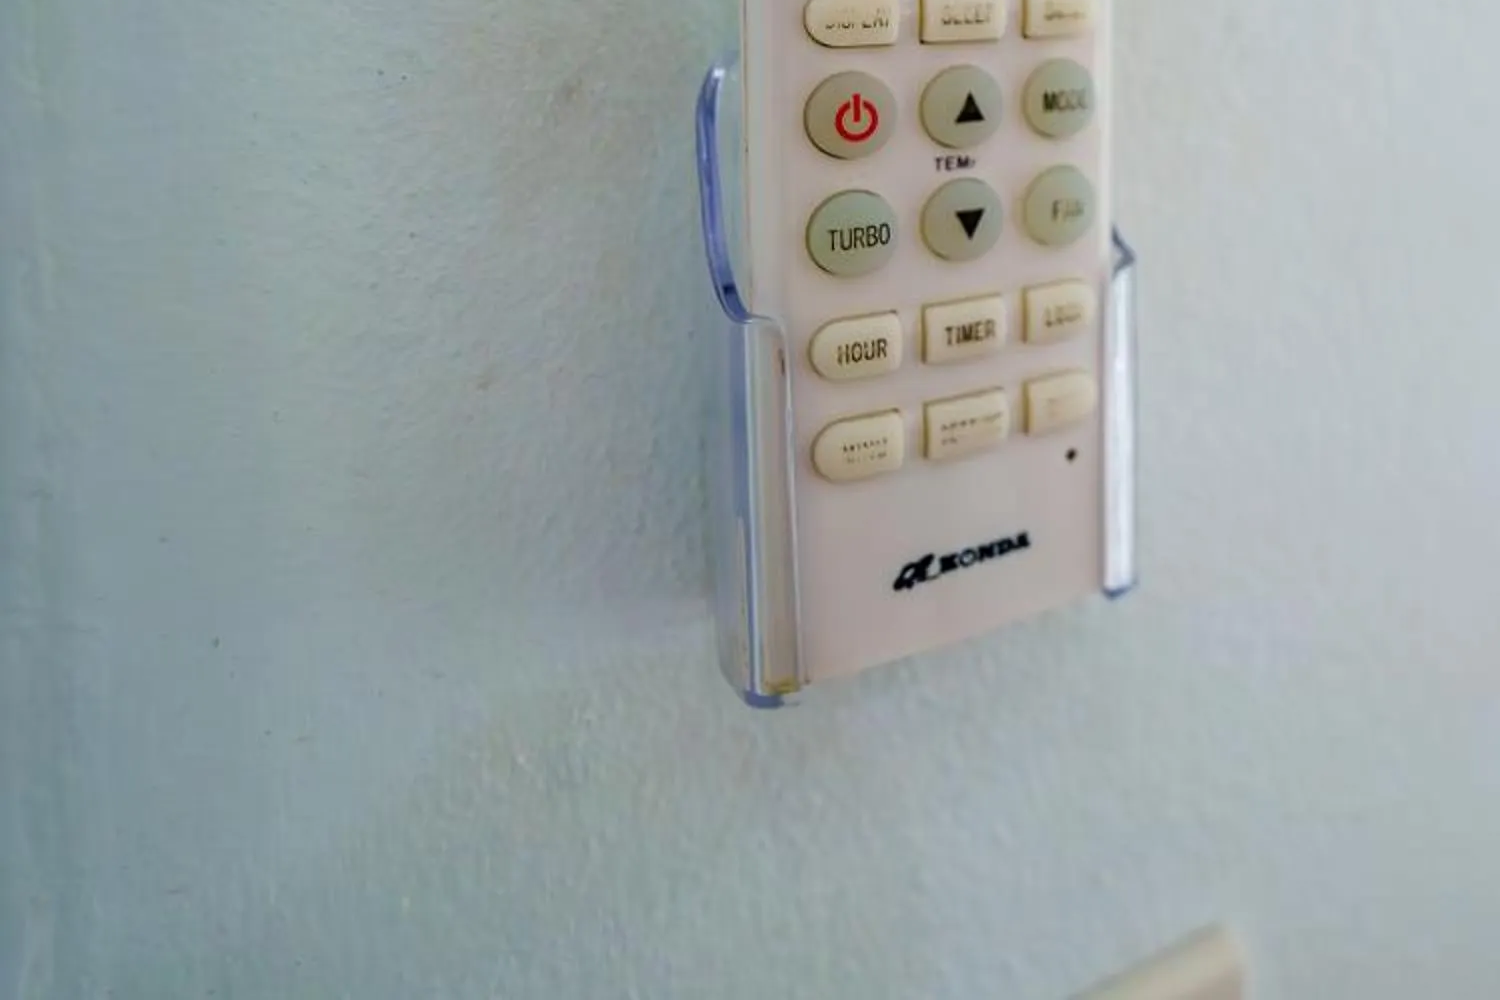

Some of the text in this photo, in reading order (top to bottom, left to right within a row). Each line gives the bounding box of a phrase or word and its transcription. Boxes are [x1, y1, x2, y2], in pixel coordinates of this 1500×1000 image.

[934, 155, 976, 172] TEM
[828, 222, 891, 251] TURBO
[944, 317, 996, 346] TIMER
[836, 337, 888, 366] HOUR
